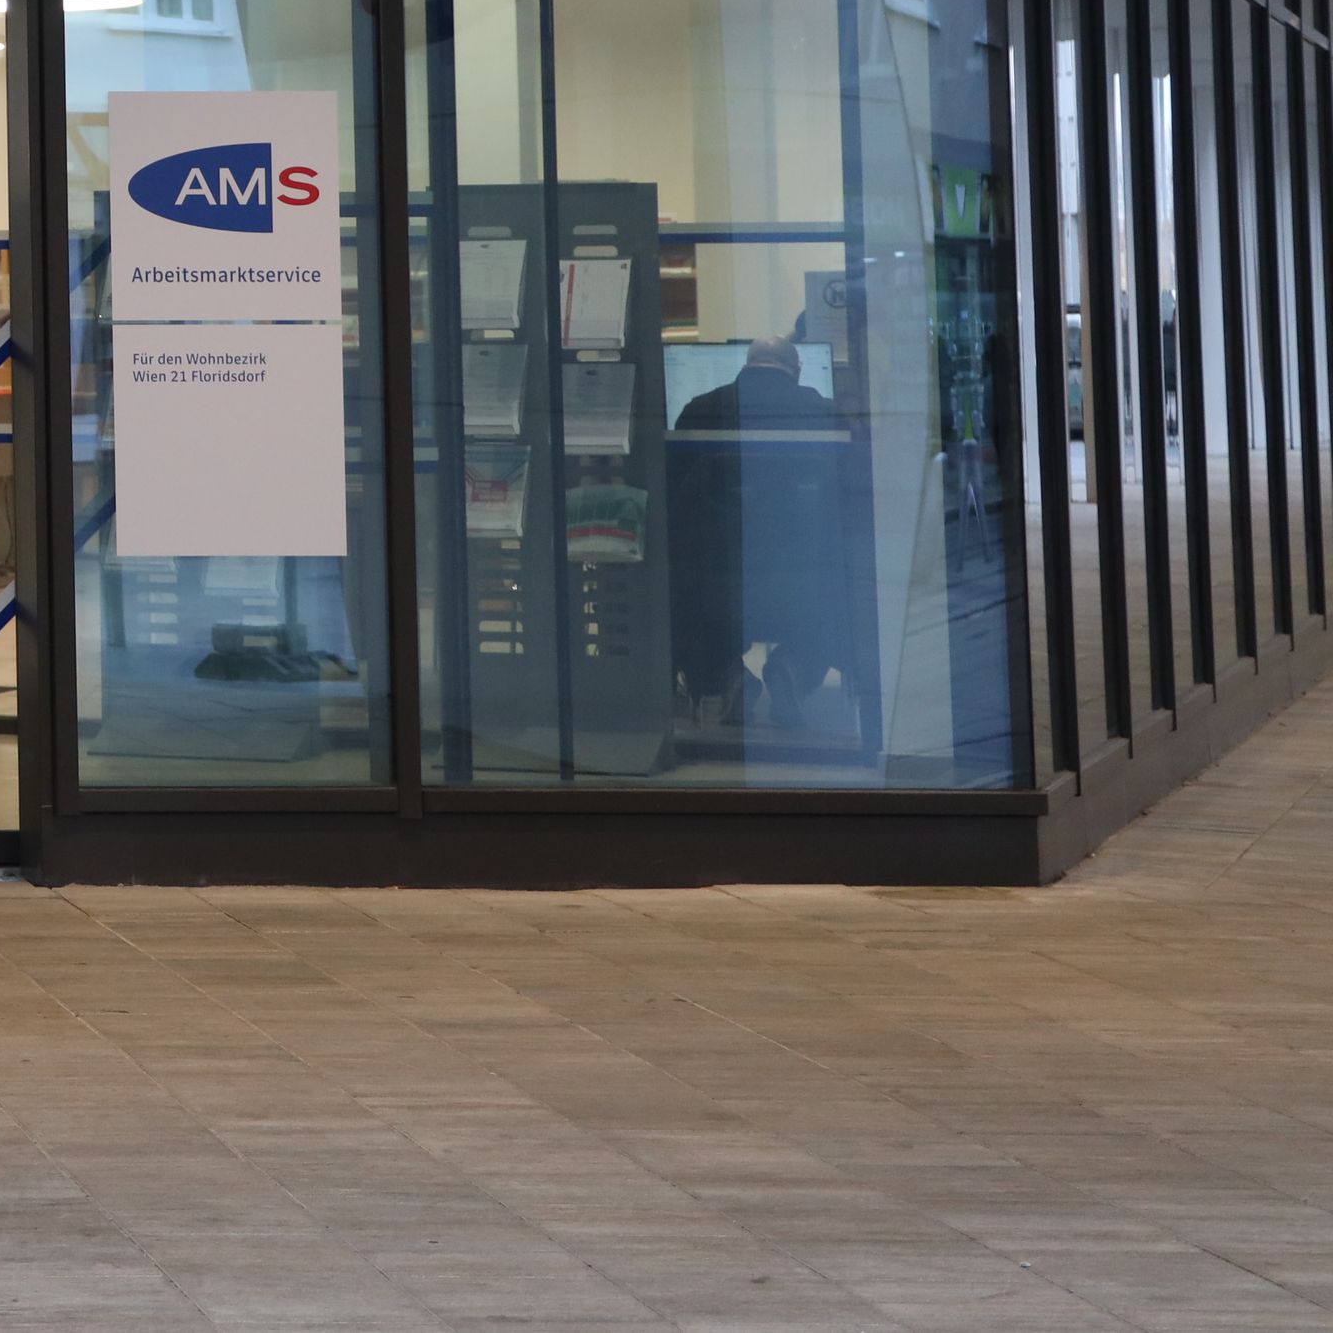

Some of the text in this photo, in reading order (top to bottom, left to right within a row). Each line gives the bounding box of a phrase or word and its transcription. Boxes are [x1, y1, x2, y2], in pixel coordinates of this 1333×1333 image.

[174, 166, 321, 206] AMS
[132, 266, 322, 284] Arbeitsmarktservice
[133, 352, 267, 365] Für den Wohnbezirk
[133, 370, 266, 382] Wien 21 Floridsdorf
